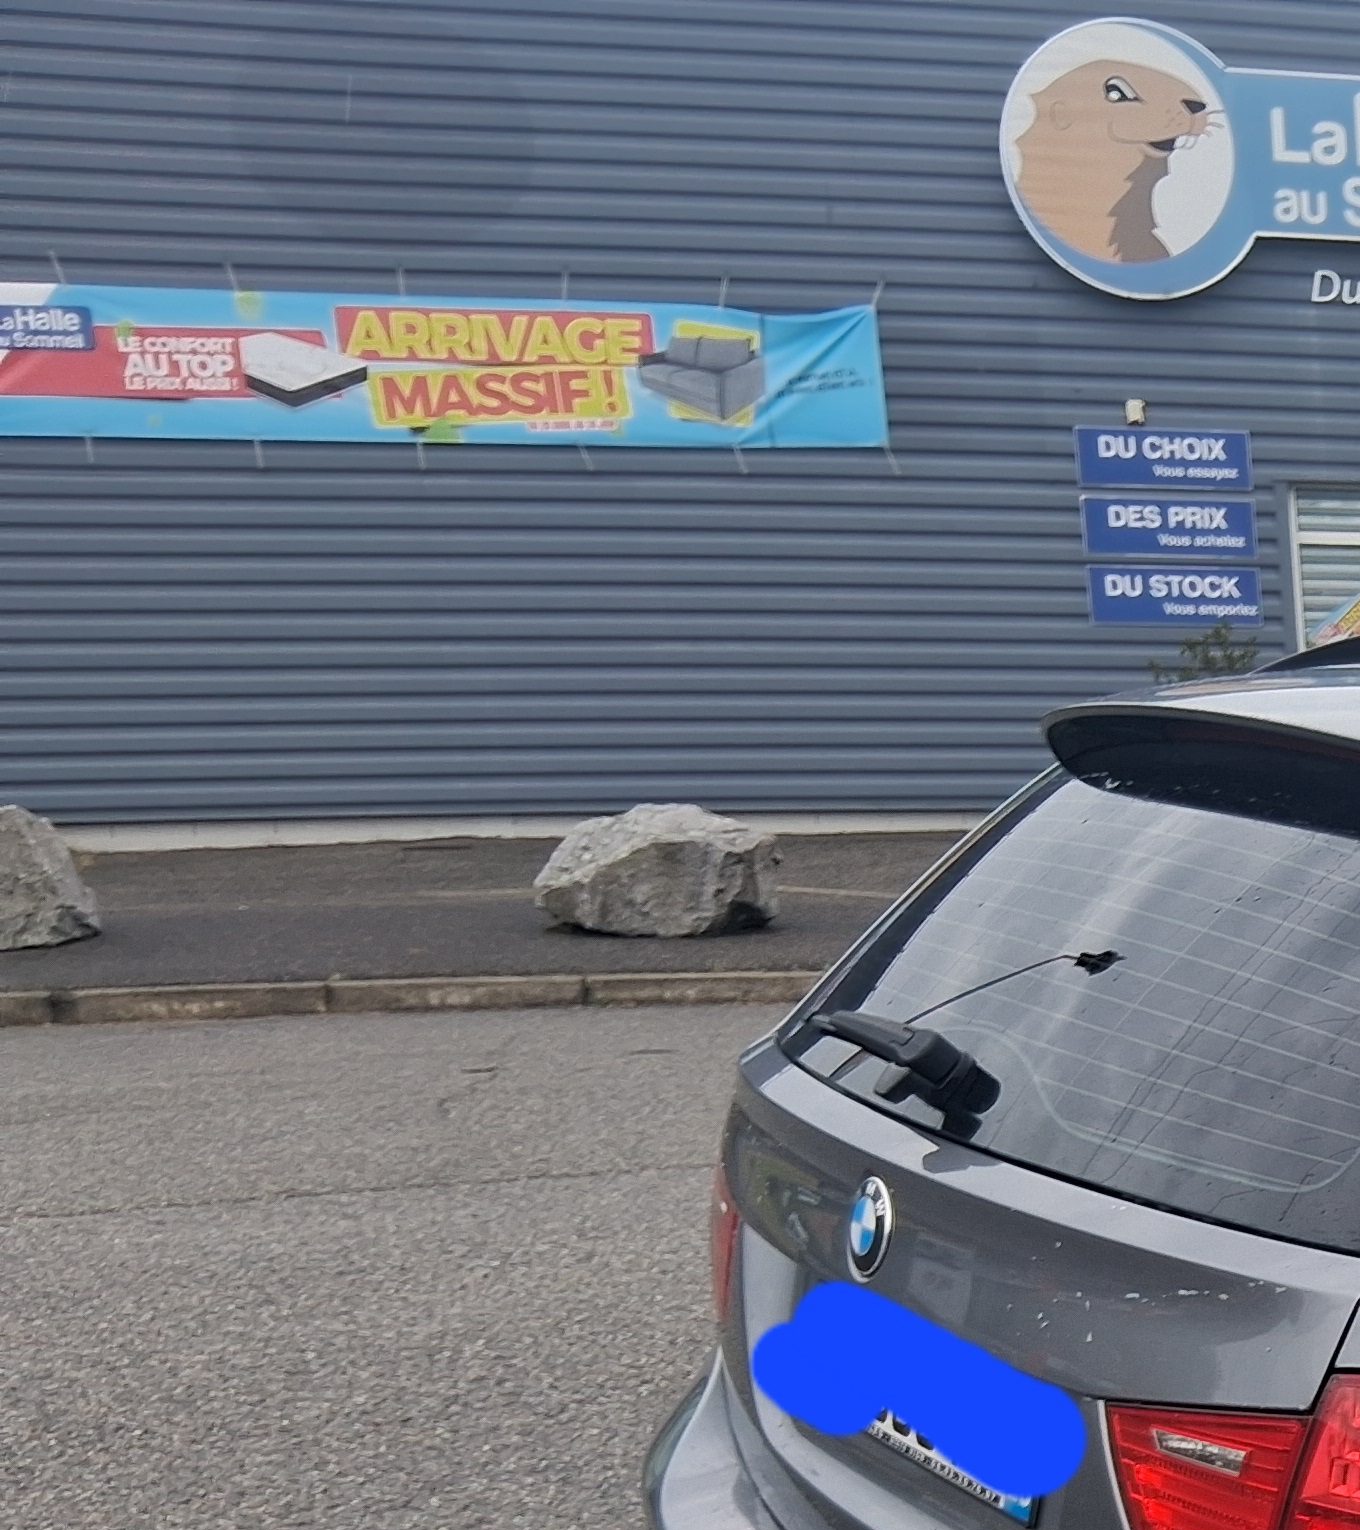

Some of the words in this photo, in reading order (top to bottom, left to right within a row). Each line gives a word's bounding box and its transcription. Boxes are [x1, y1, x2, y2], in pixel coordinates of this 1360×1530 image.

[1273, 187, 1327, 224] au
[344, 310, 643, 366] ARRIVAGE
[124, 353, 169, 377] AU
[171, 354, 235, 378] TOP
[1097, 434, 1136, 459] DU
[1142, 435, 1227, 461] CHOIX
[1152, 464, 1185, 477] Vous
[1107, 505, 1162, 529] DES
[1167, 506, 1228, 530] PRIX
[1157, 533, 1191, 547] Vous
[1104, 574, 1143, 597] DU
[1149, 574, 1242, 598] STOCK
[1162, 601, 1196, 615] Vous
